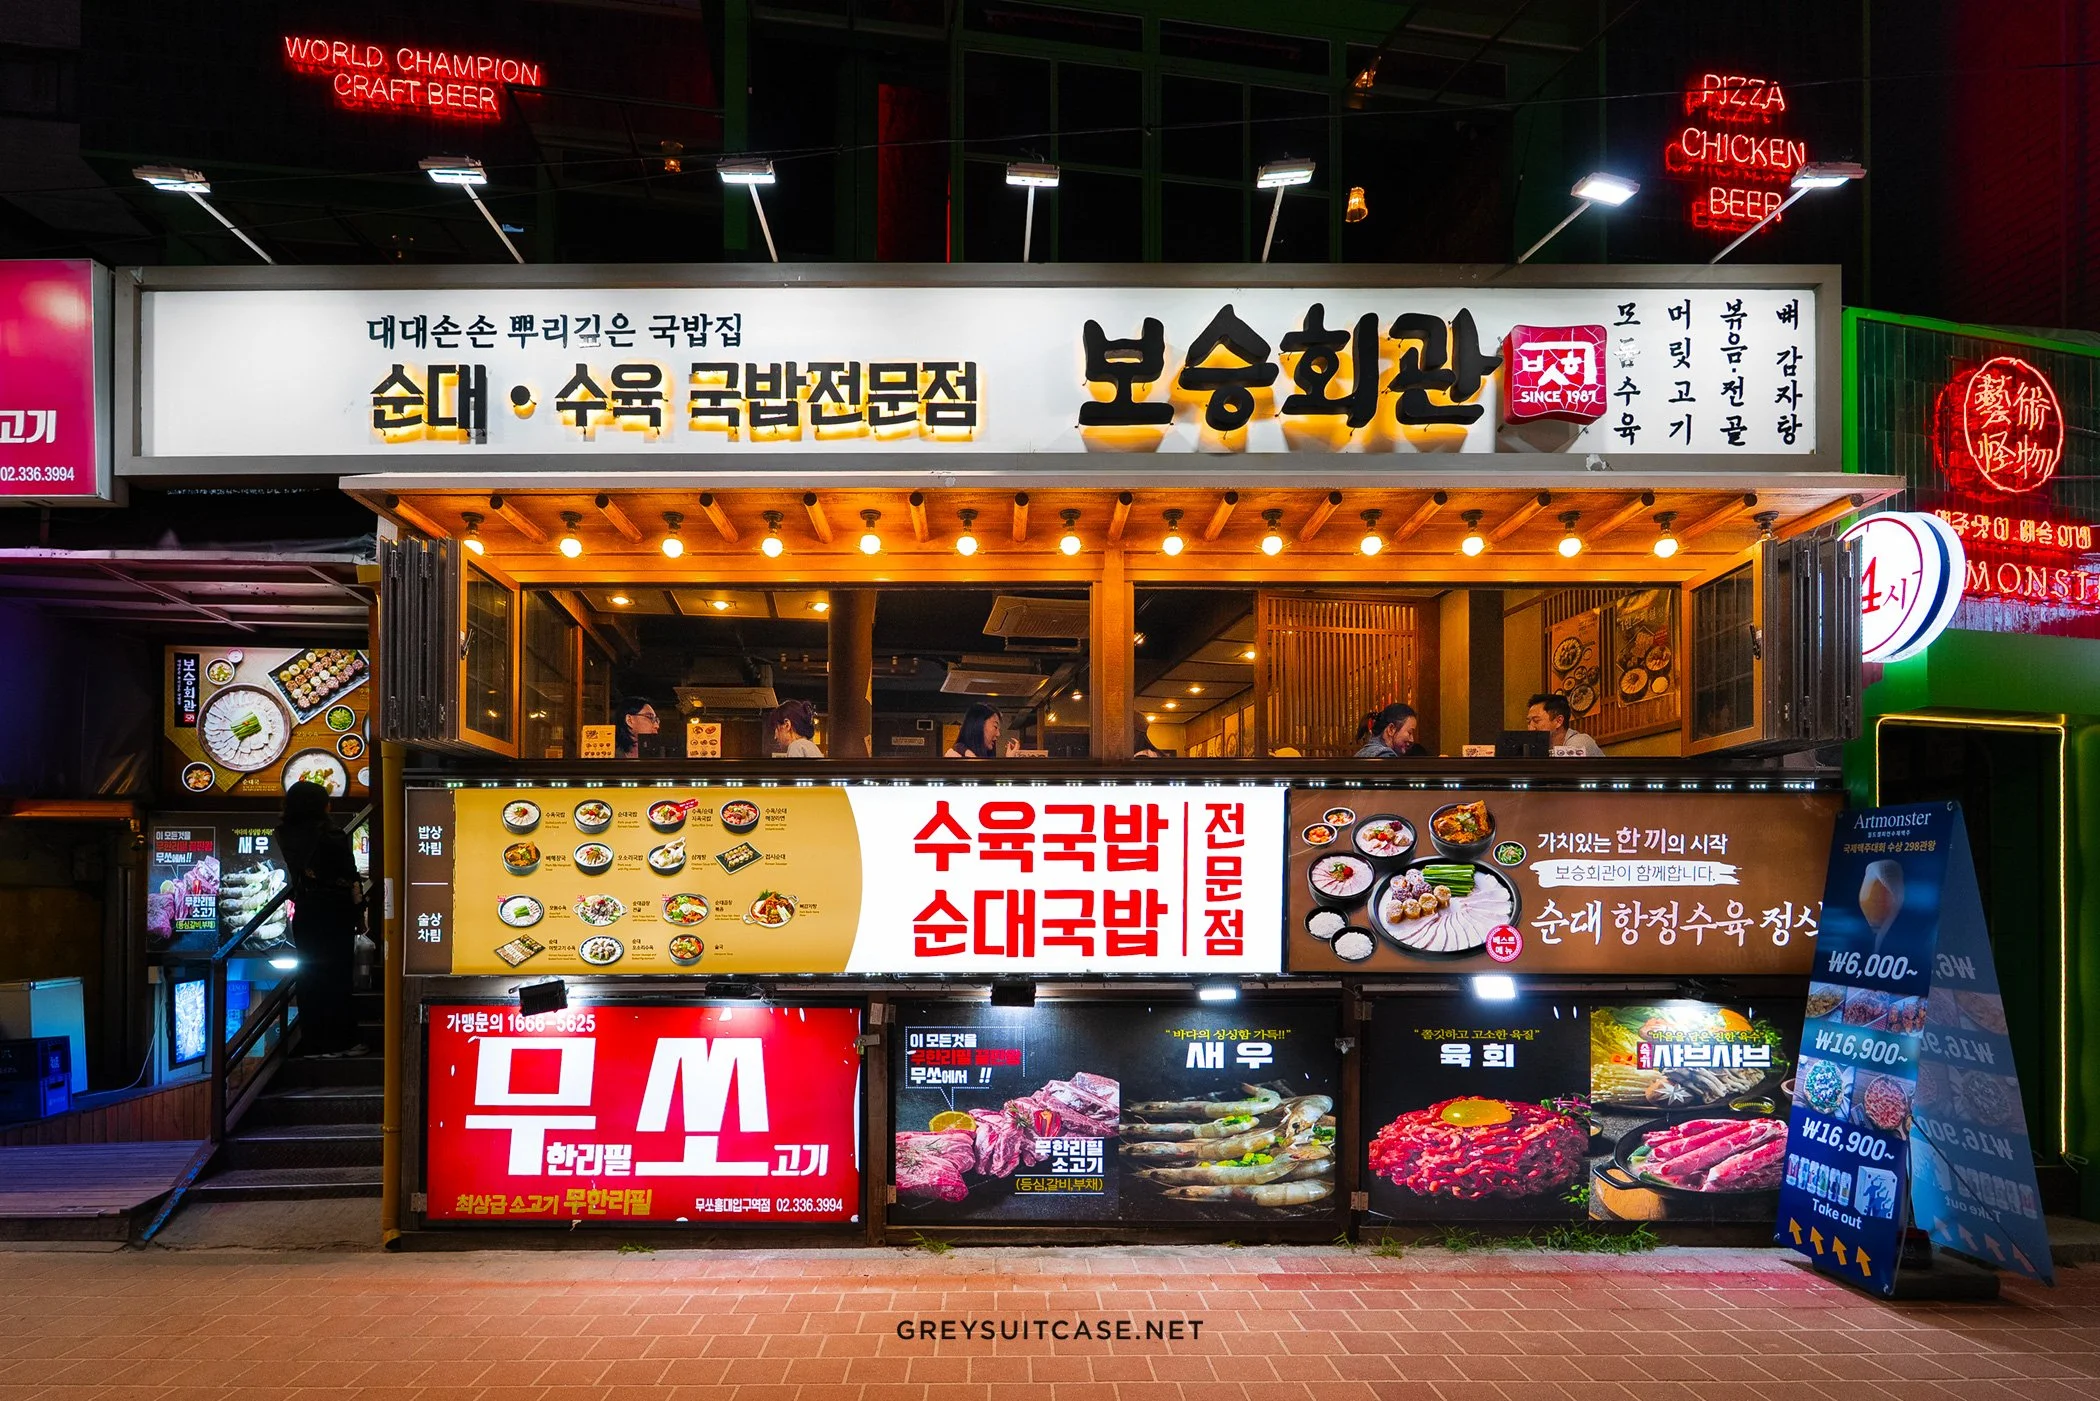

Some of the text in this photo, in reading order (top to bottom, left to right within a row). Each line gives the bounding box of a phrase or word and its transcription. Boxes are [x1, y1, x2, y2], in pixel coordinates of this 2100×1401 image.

[285, 36, 538, 86] WORLD CHAMPION
[334, 73, 497, 110] CRAFT BEER
[1703, 74, 1786, 111] PIZZA
[1682, 127, 1805, 168] CHICKEN
[1710, 187, 1782, 221] BEER
[367, 314, 497, 349] 대대손손
[648, 312, 742, 347] 국밥집
[1077, 303, 1503, 431] 보승회관
[1668, 299, 1696, 446] 머릿고기
[1775, 298, 1804, 445] 뼈감자탕
[371, 361, 976, 430] 순대 수육 국밥전문점
[1521, 390, 1596, 402] SINCE 1987
[0, 466, 75, 481] 02.336.3994
[183, 659, 197, 712] 보승회관
[1853, 811, 1932, 829] Artmonster
[418, 826, 443, 840] 밥상
[913, 801, 1169, 873] 수육국밥
[418, 842, 443, 855] 차림
[1537, 833, 1612, 854] 가치있는
[1690, 833, 1728, 854] 시작
[1843, 842, 1886, 854] 국제맥주대회
[1887, 841, 1902, 852] 수상
[1204, 802, 1245, 956] 전문점
[1555, 864, 1716, 882] 보승회관이 함께합니다.
[192, 907, 216, 918] 소고기
[418, 913, 442, 927] 술상
[912, 888, 1168, 958] 순대국밥
[1530, 899, 1602, 945] 순대
[1611, 899, 1755, 947] 항정수육
[418, 929, 441, 942] 차림
[1492, 936, 1515, 945] 베스트
[1495, 946, 1513, 955] 메뉴
[446, 1012, 503, 1032] 가맹문의
[910, 1033, 977, 1048] 이 모든것을
[1213, 1029, 1251, 1040] 싱싱함
[1471, 1029, 1508, 1040] 고소한
[1653, 1044, 1771, 1068] 샤브샤브
[1035, 1139, 1103, 1157] 무한리필
[1051, 1157, 1103, 1174] 소고기
[456, 1188, 653, 1216] 최상급 소고기 무한리필
[776, 1197, 843, 1212] 02.336.3994
[1812, 1198, 1862, 1229] Take out
